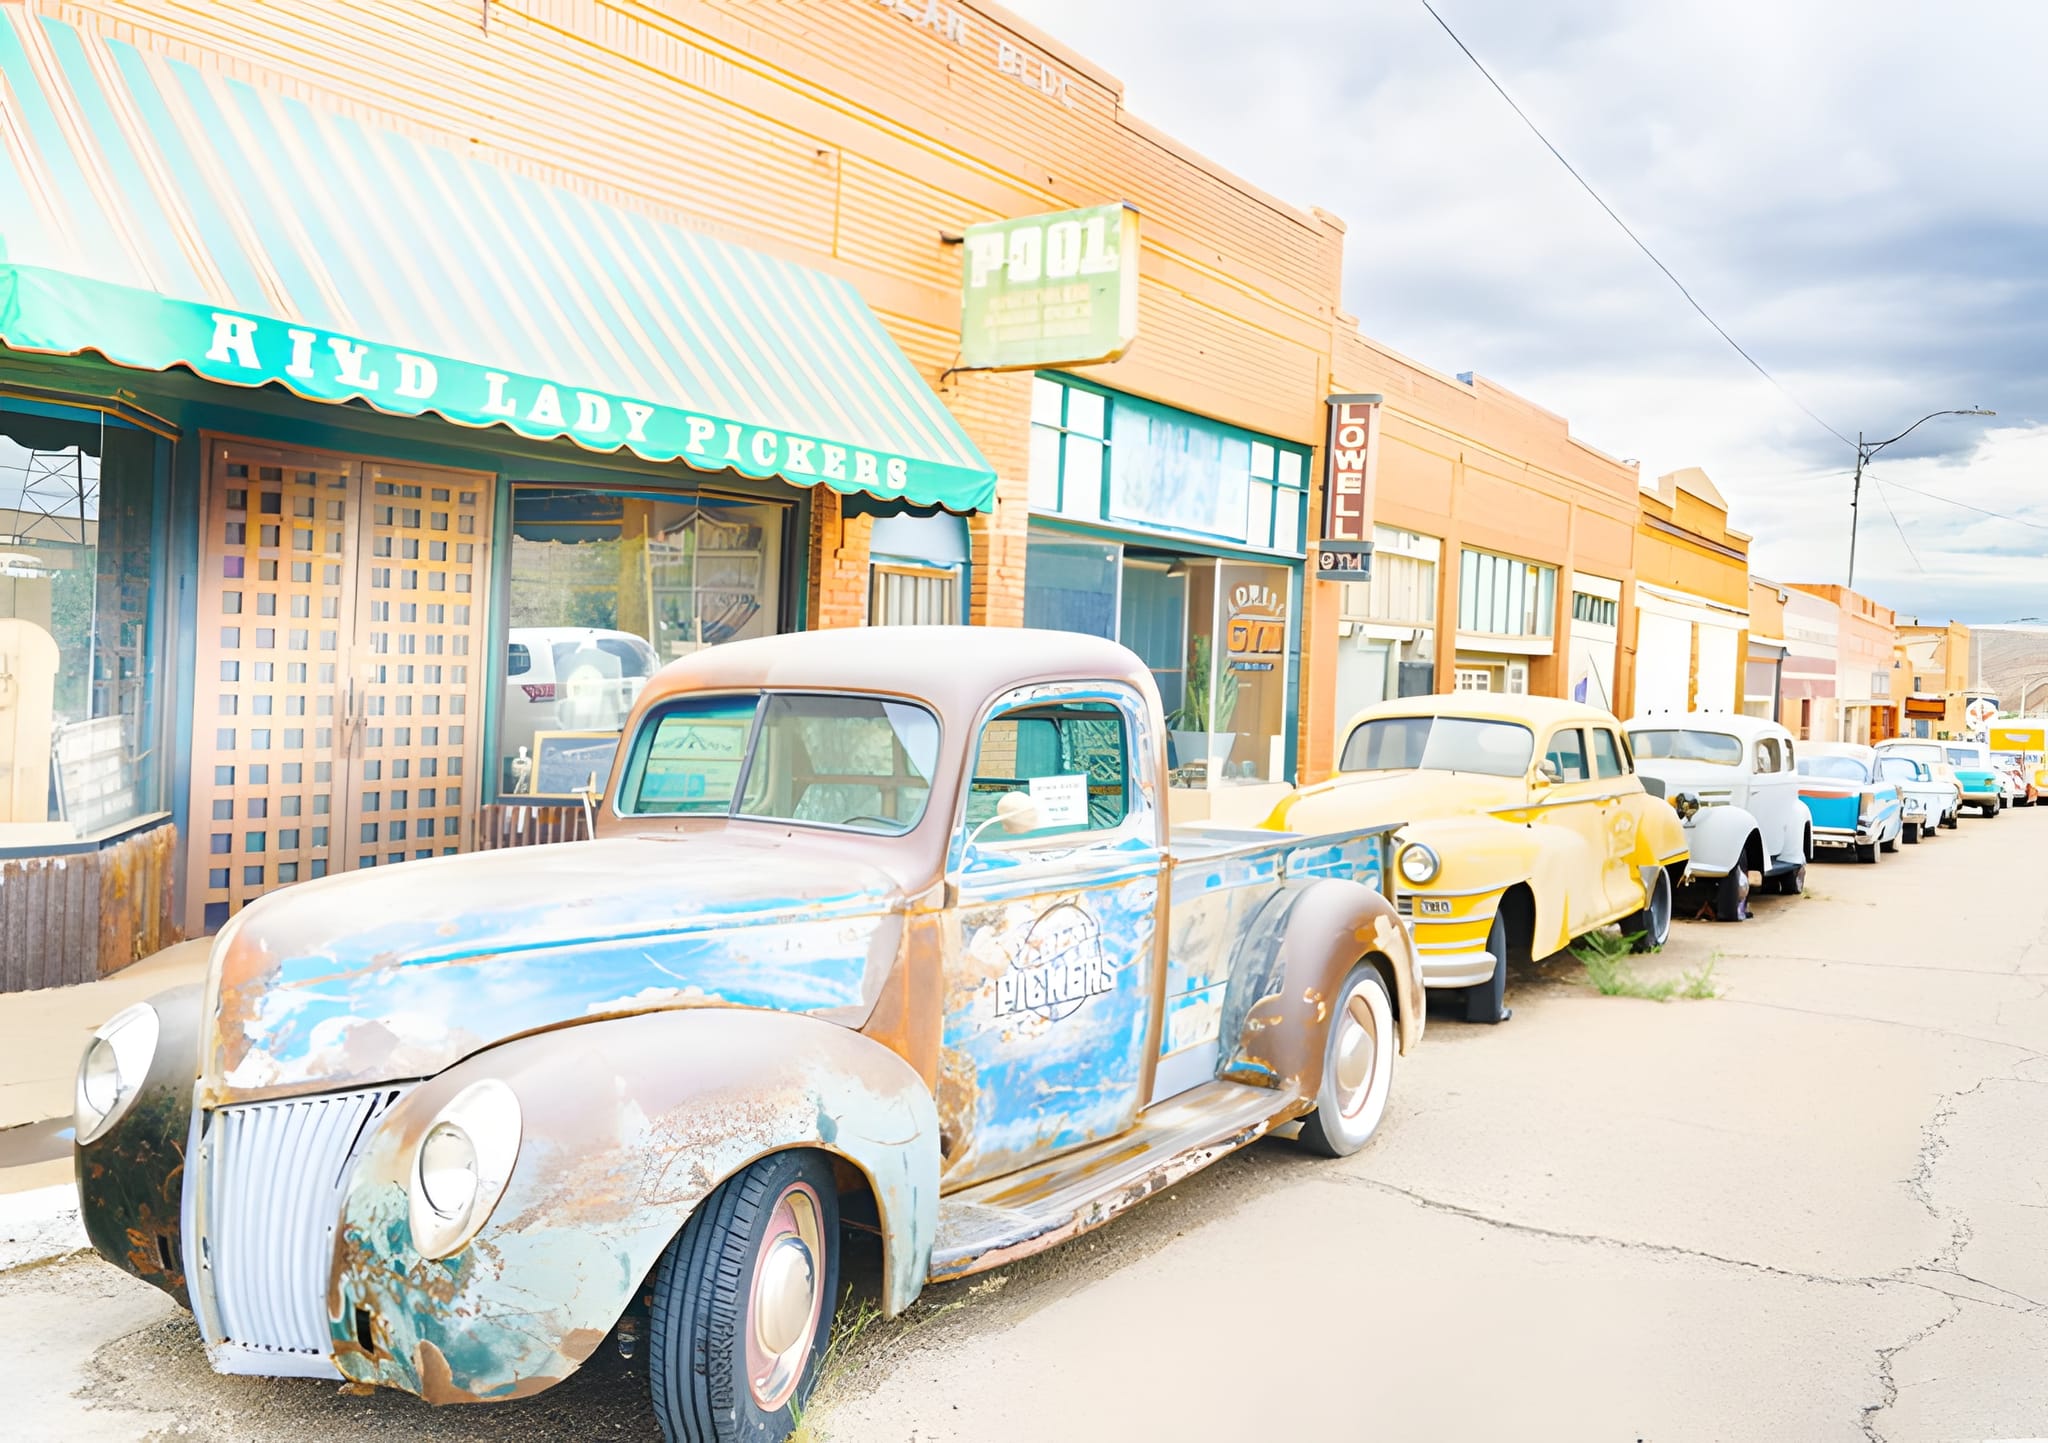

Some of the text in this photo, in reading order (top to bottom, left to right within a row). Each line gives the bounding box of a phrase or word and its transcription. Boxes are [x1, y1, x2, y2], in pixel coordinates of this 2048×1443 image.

[966, 216, 1121, 288] POOL
[480, 371, 655, 443] LADY
[684, 415, 908, 490] PICKERS
[1334, 402, 1367, 540] LOWELL
